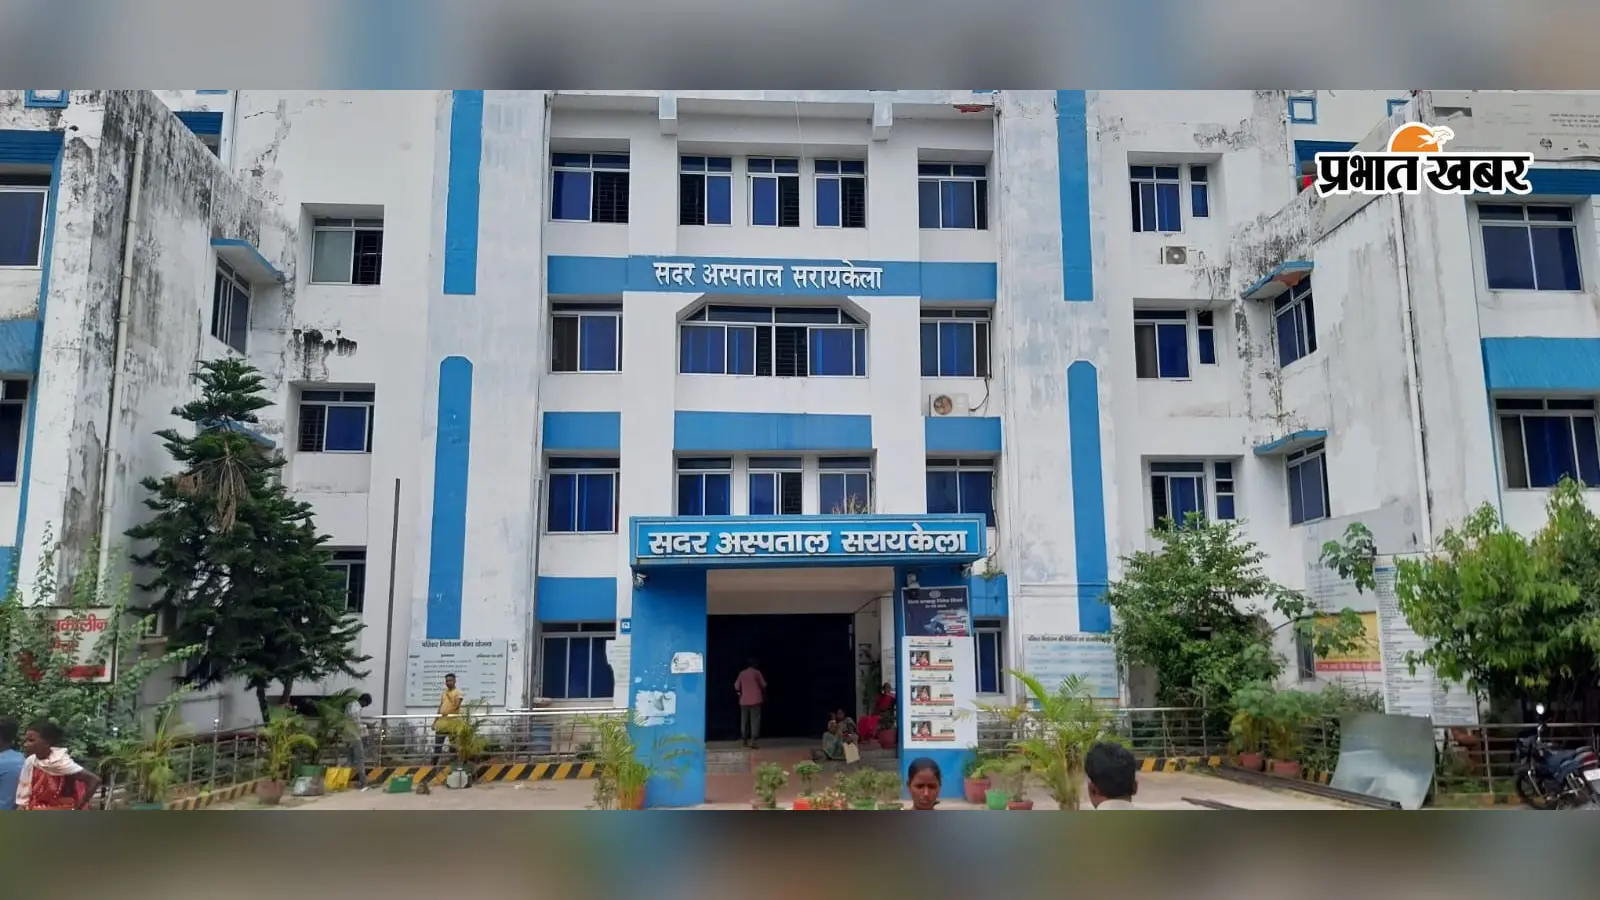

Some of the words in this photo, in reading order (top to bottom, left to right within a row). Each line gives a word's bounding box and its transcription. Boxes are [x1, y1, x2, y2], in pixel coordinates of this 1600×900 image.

[653, 262, 696, 287] सदर
[702, 264, 784, 288] अस्पताल
[791, 258, 884, 290] सरायकेला
[648, 531, 709, 555] सदर
[715, 531, 832, 555] अस्पताल
[840, 522, 968, 555] सरायकेला
